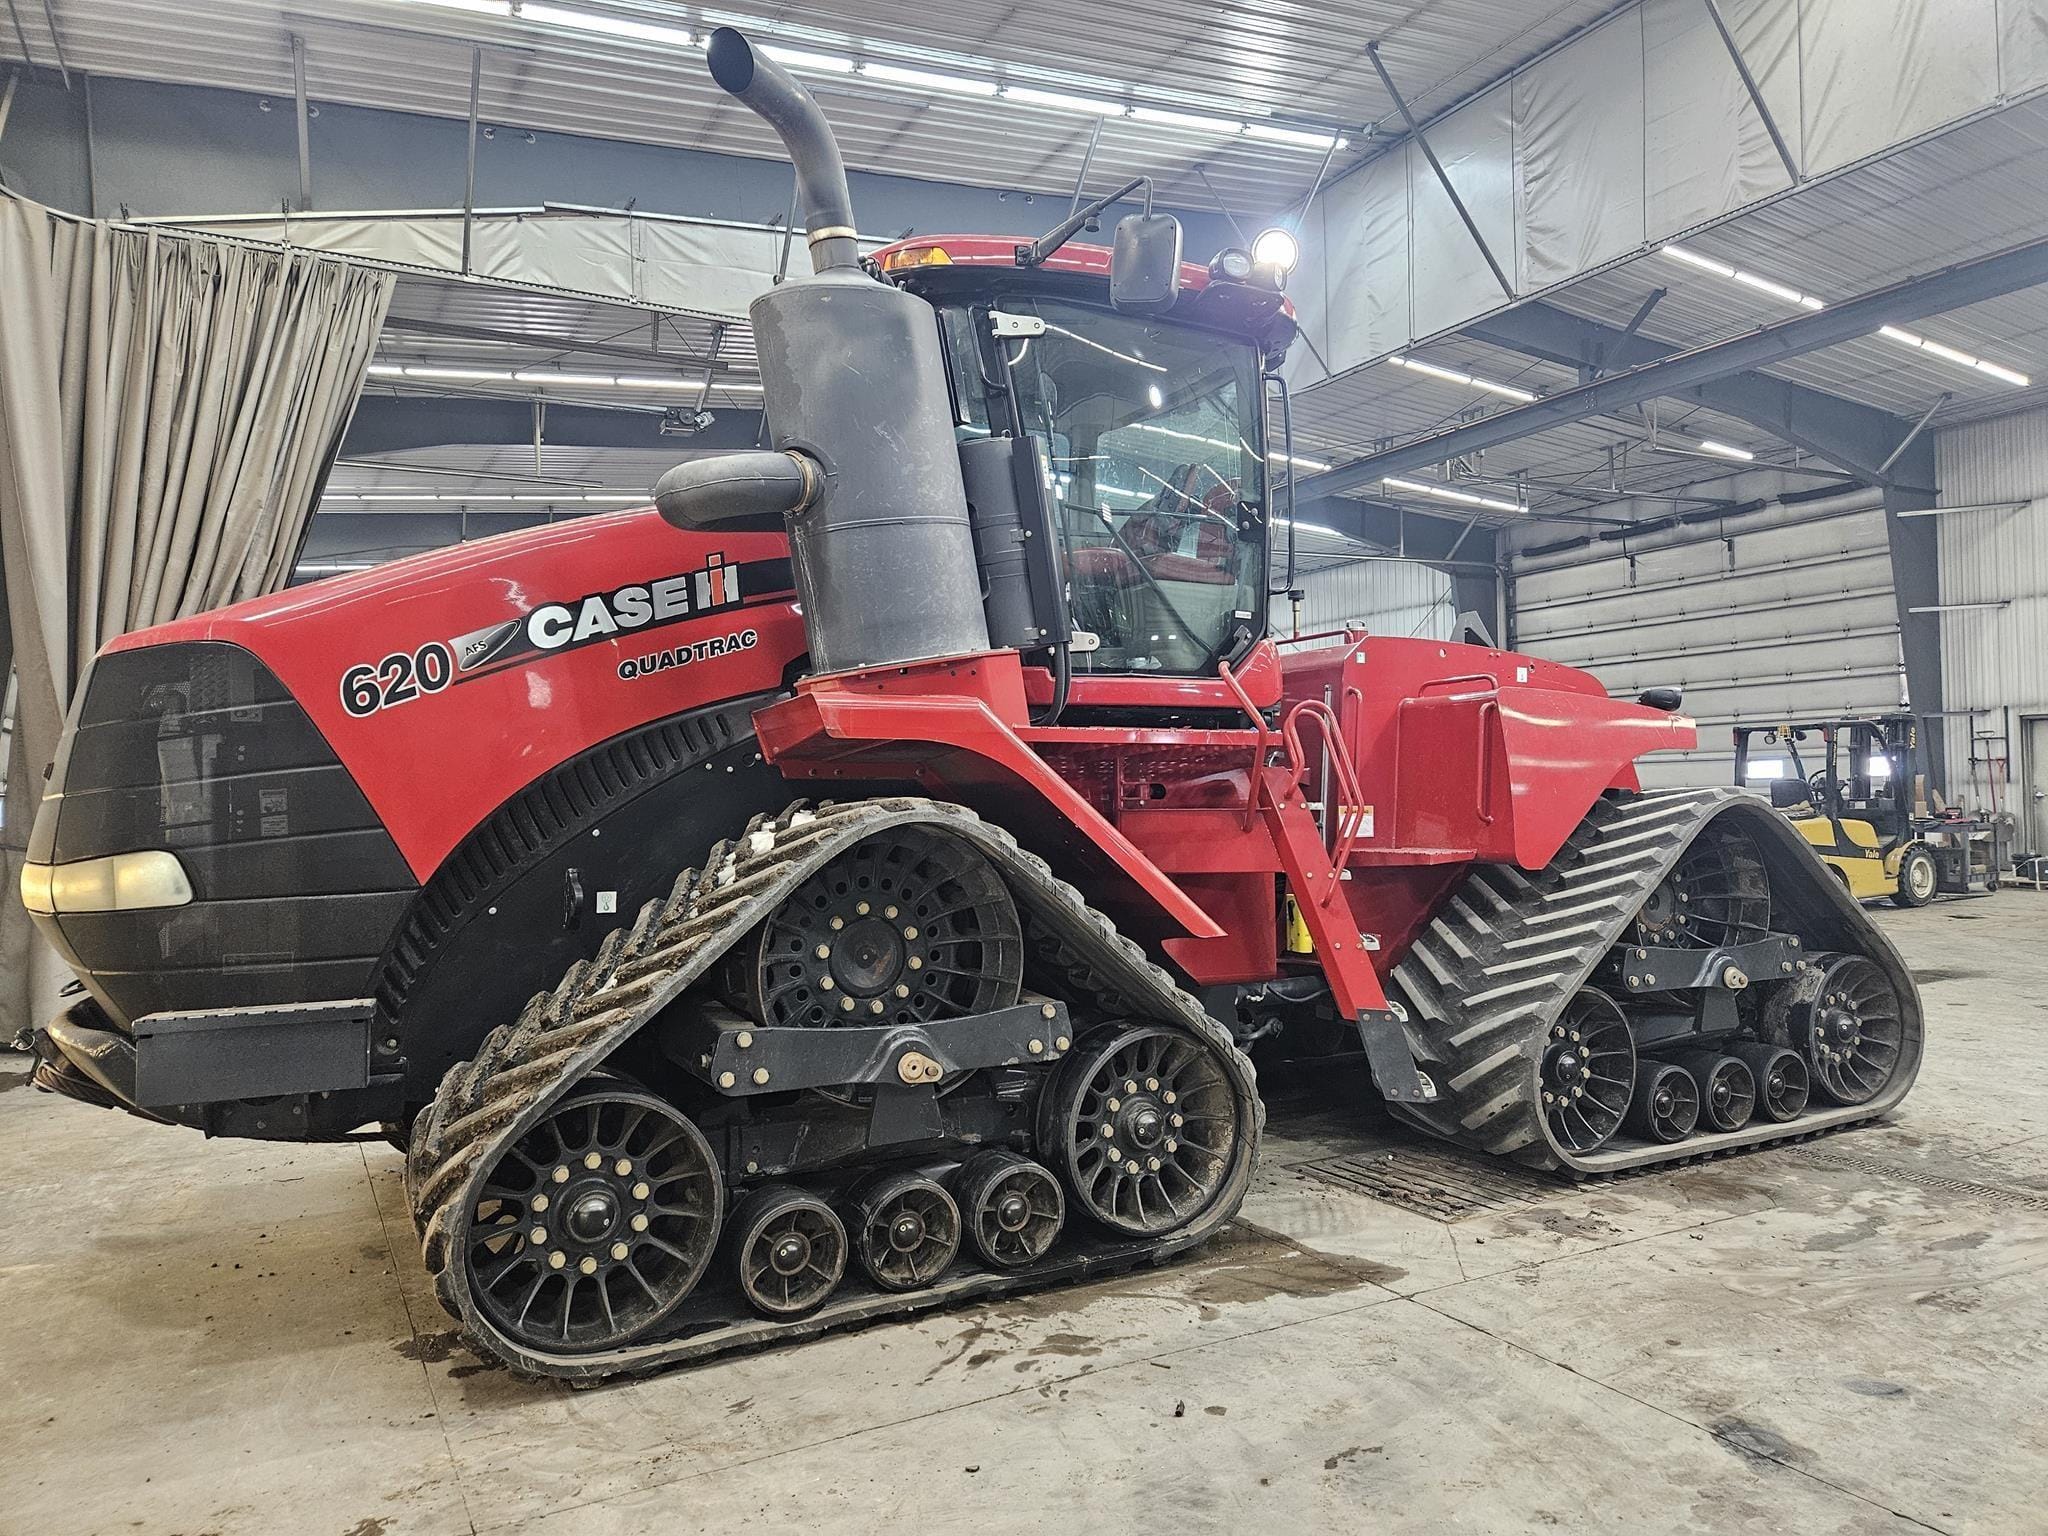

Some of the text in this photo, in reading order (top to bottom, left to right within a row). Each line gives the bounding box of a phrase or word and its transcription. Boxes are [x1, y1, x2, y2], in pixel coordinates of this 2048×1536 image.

[527, 576, 689, 649] CASE
[465, 640, 488, 656] AFS
[617, 628, 758, 680] QUADTRAC
[340, 641, 453, 718] 620
[1908, 726, 1917, 750] Yale
[1864, 848, 1880, 859] Yale
